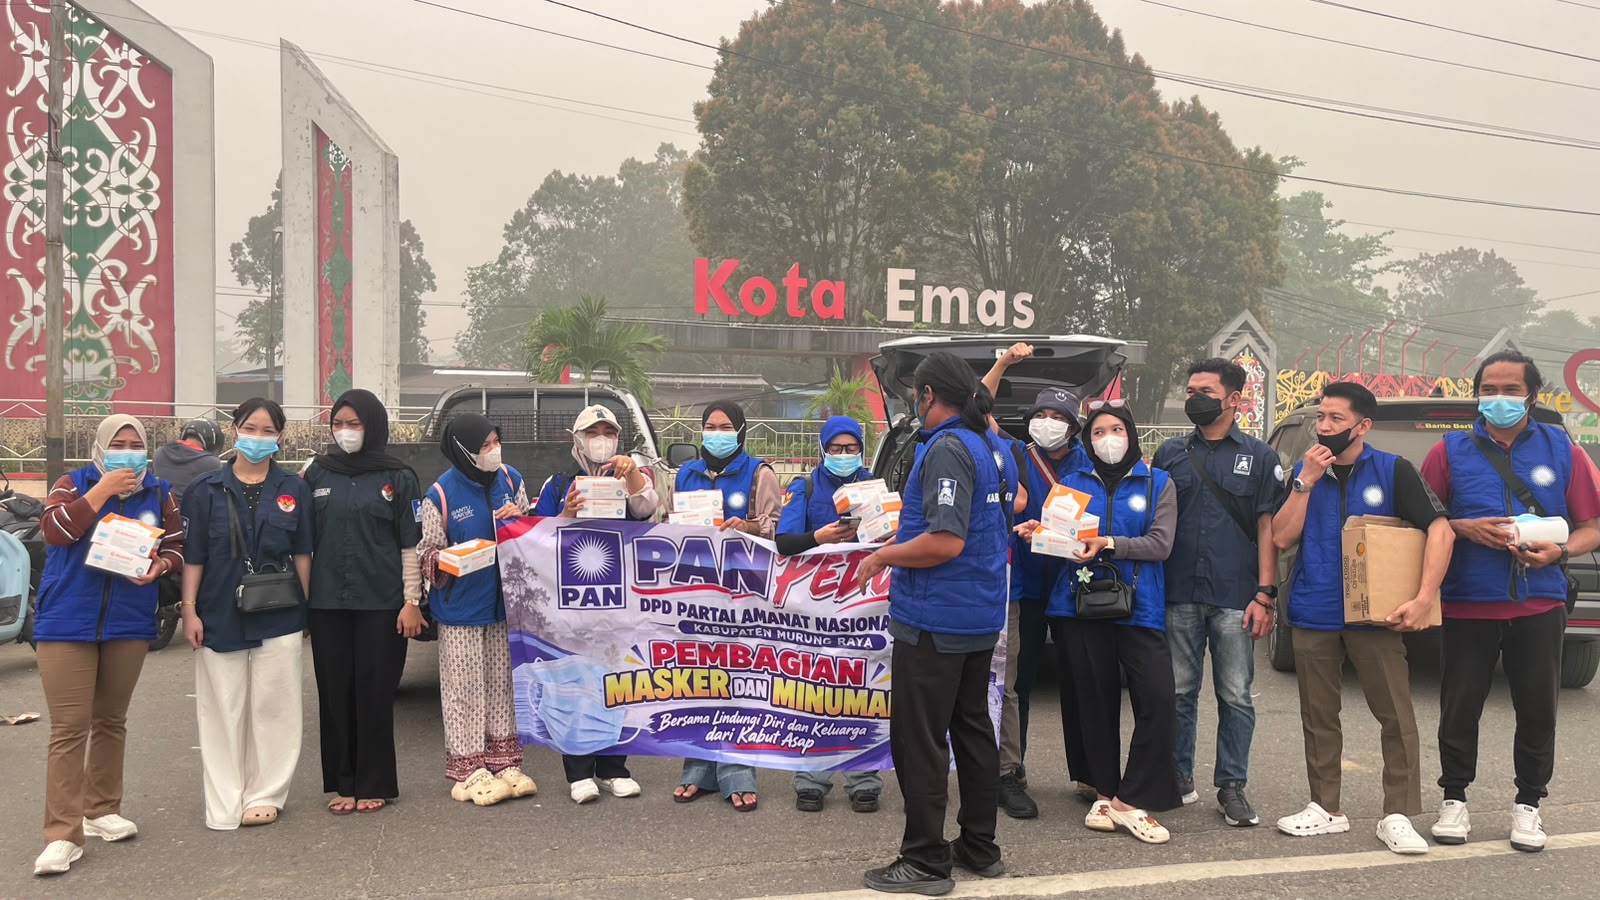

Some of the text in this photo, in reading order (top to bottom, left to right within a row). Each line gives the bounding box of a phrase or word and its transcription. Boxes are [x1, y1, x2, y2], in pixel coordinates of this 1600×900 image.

[694, 257, 1035, 329] Kota Emas
[1537, 391, 1572, 413] ve
[632, 536, 891, 607] PAN PEDU
[561, 586, 622, 607] PAN
[640, 598, 891, 633] DPD PARTAI AMANAT NASIONA
[694, 624, 873, 648] KABUPATEN MURUNG RAYA
[650, 641, 866, 686] PEMBAGIAN
[604, 668, 891, 718] MASKER DAN MINUMA
[657, 710, 867, 741] Bersama Lindungi Diri dan Keluarga
[705, 726, 815, 754] dari Kabut Asap
